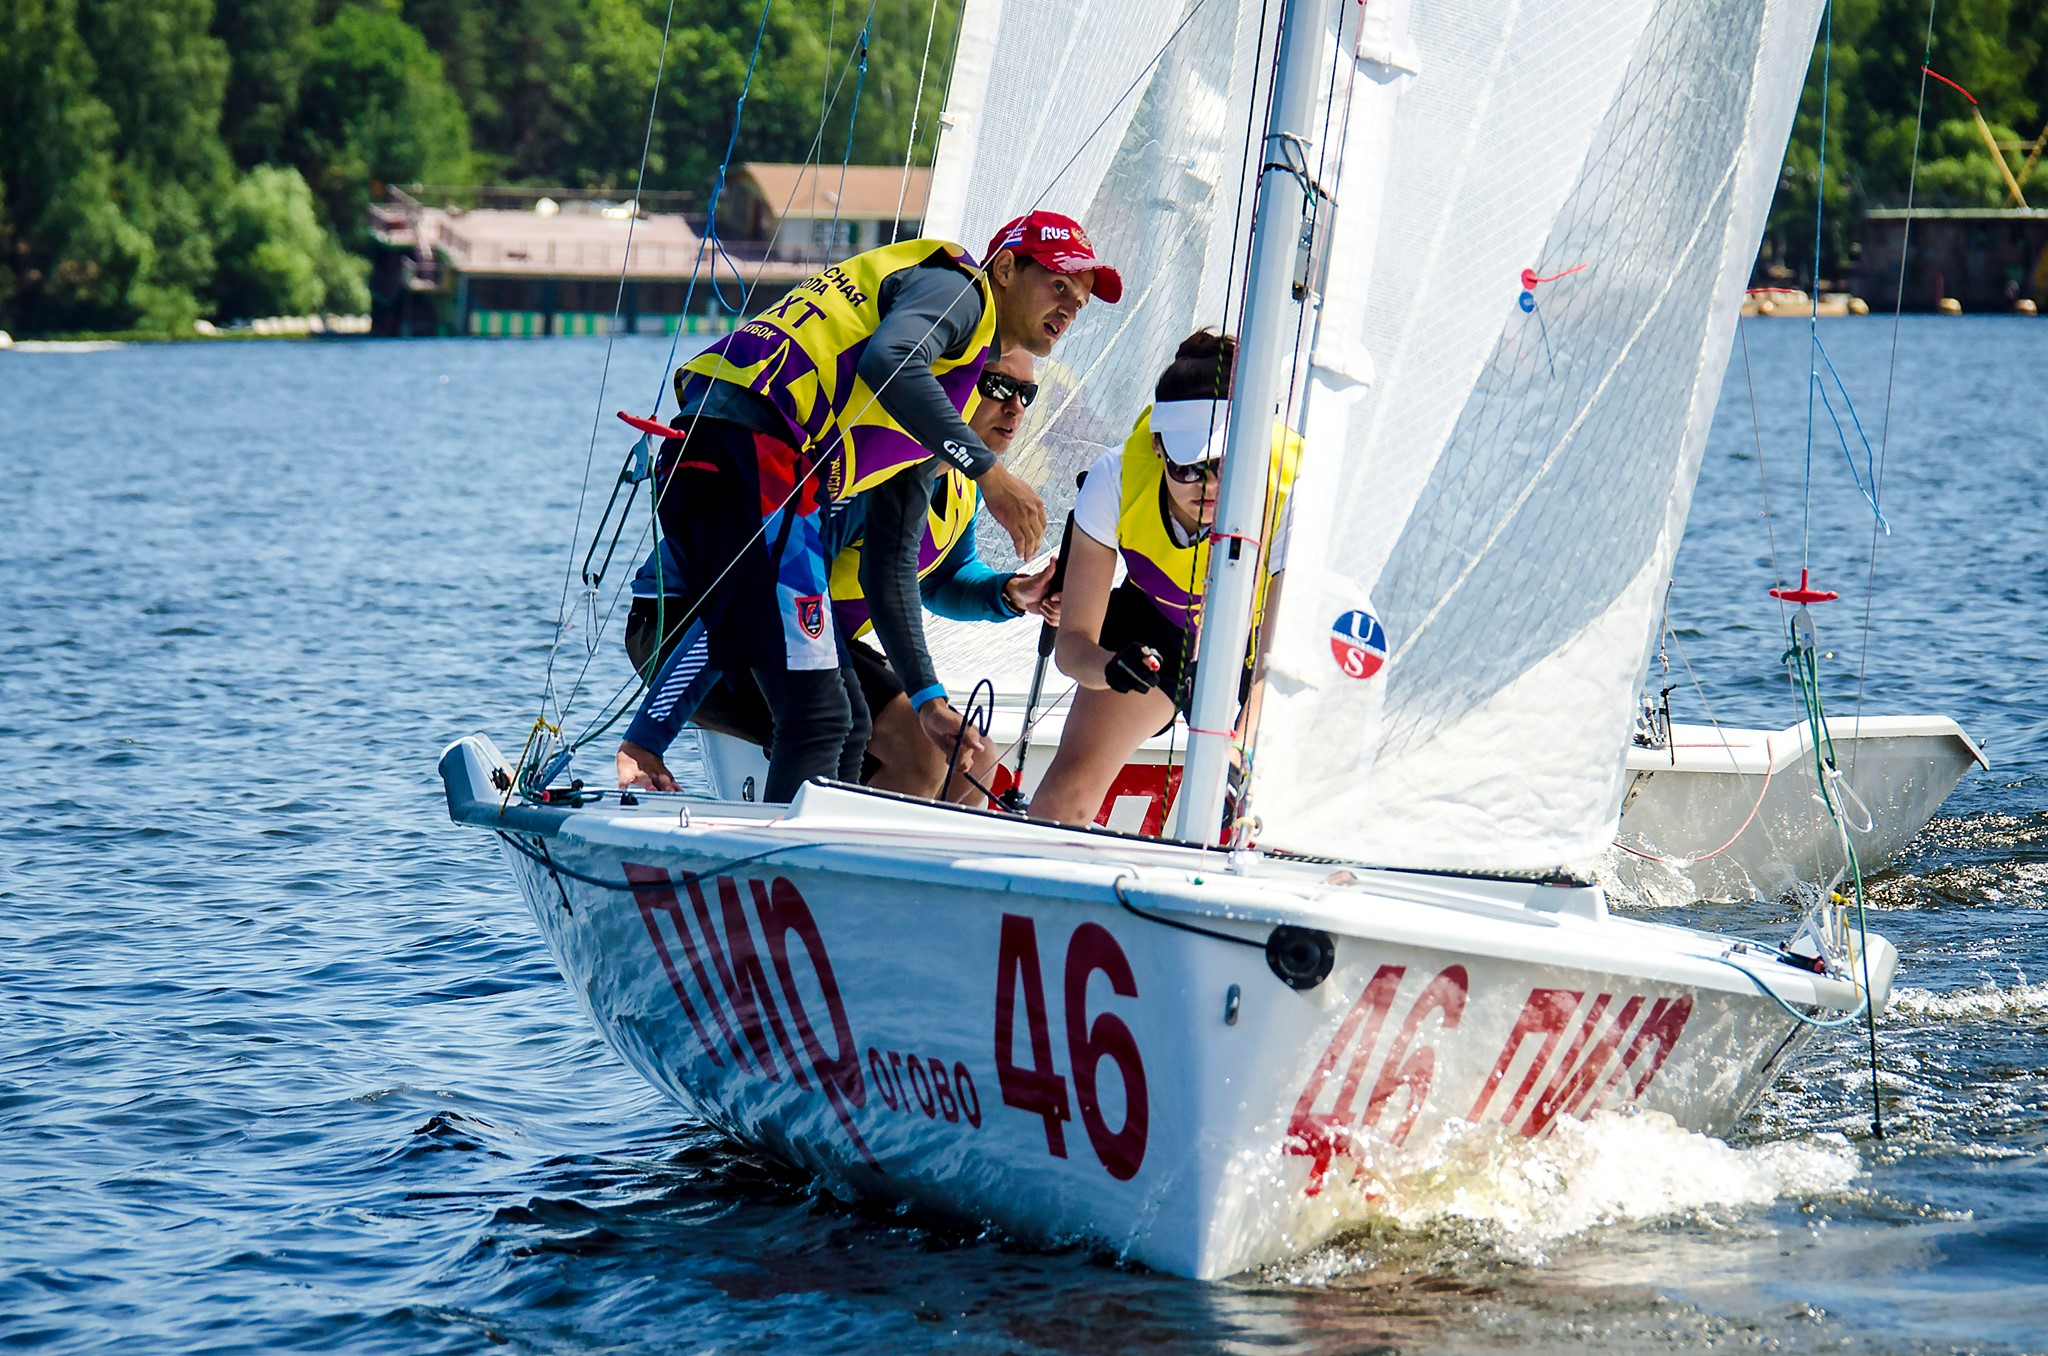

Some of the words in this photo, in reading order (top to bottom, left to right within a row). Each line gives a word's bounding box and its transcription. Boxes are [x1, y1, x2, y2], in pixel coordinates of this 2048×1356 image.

[1041, 226, 1071, 240] RUS
[763, 295, 827, 329] ХТ
[943, 440, 974, 468] Gill
[995, 912, 1149, 1181] 46
[1282, 963, 1469, 1200] 46
